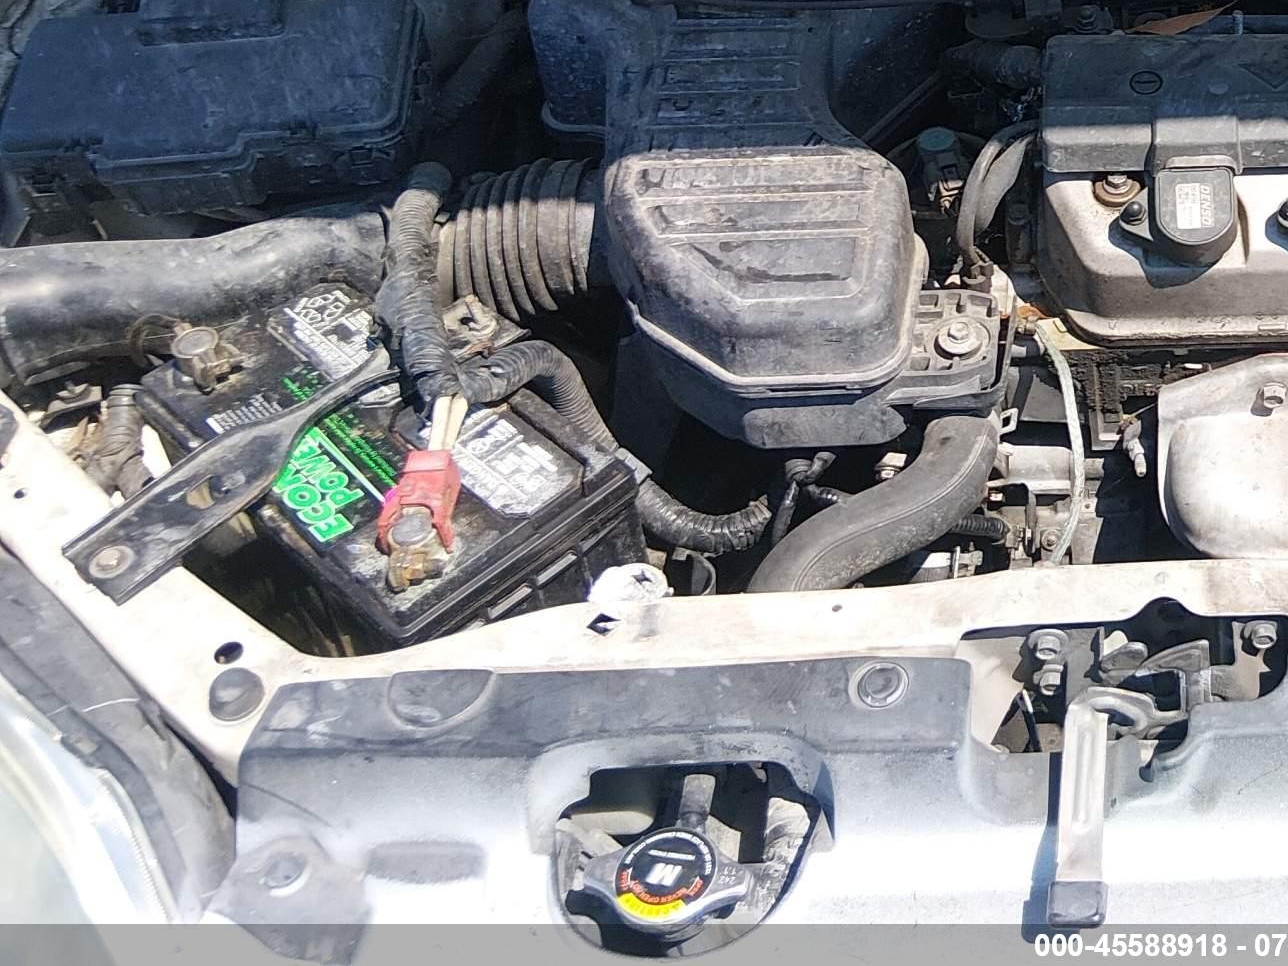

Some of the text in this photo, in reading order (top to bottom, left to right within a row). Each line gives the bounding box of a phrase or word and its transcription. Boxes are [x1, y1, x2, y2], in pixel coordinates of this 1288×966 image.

[1200, 185, 1213, 226] DENSO
[272, 465, 354, 543] ECON
[290, 431, 363, 509] POWE
